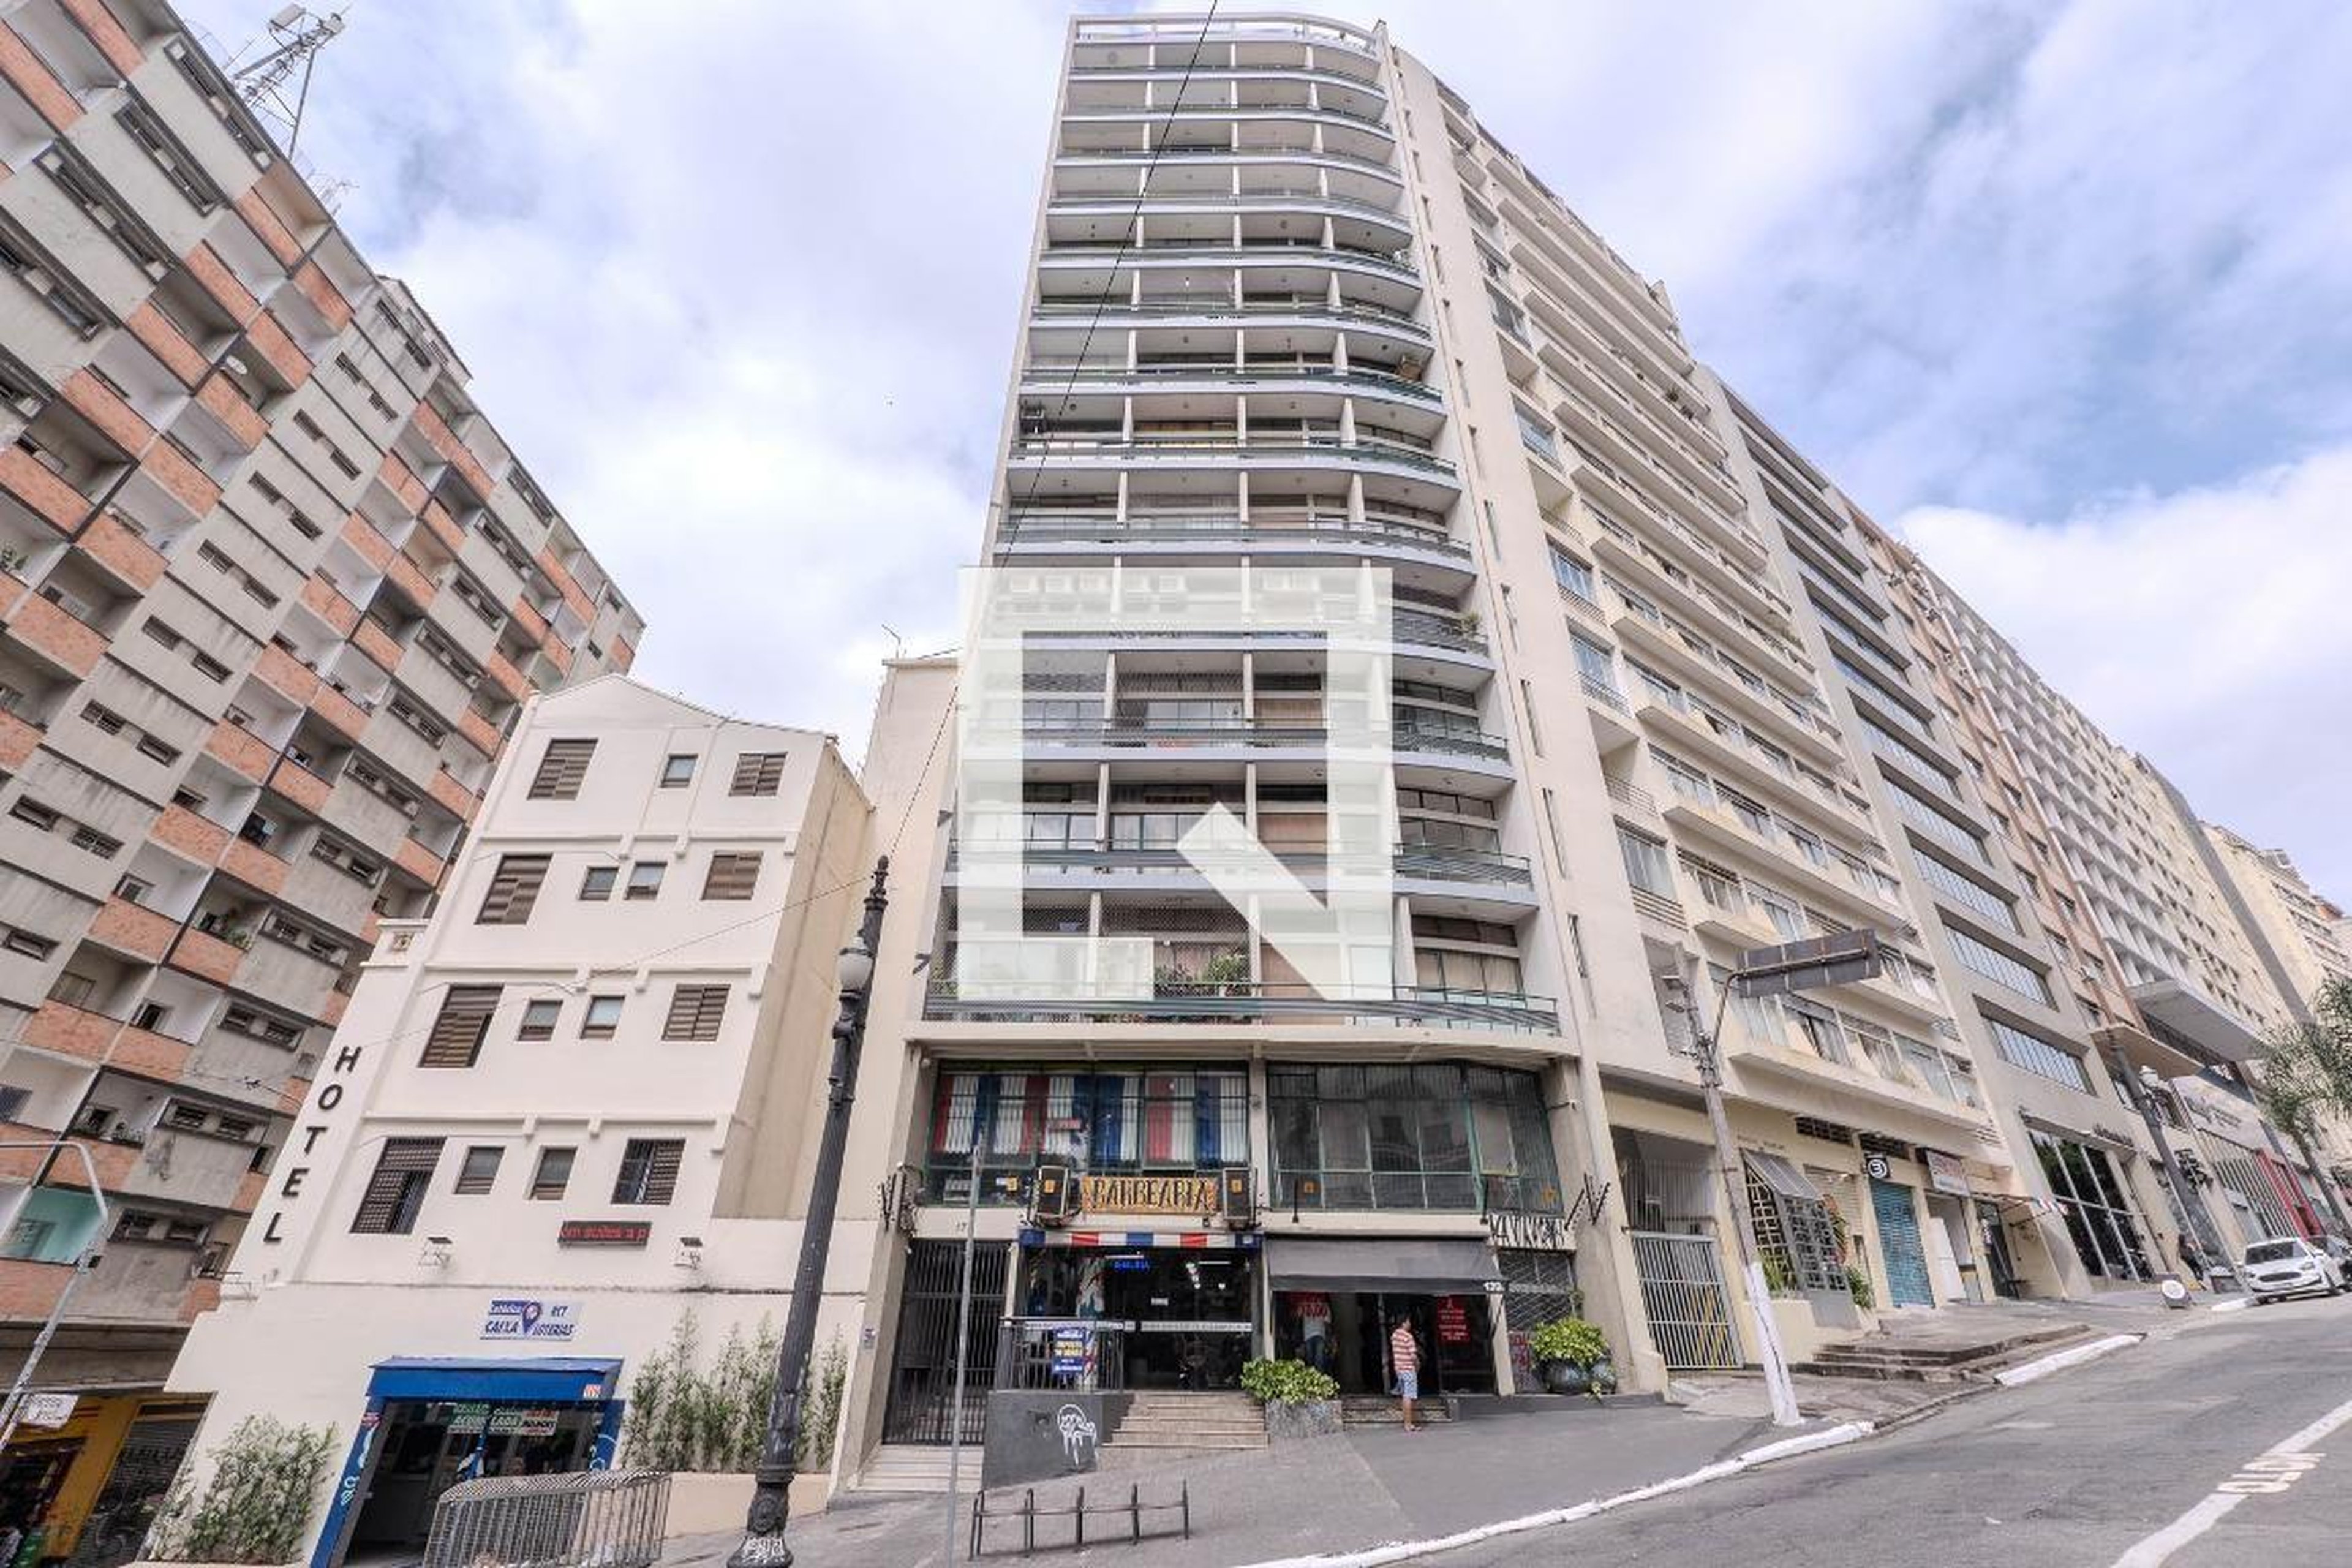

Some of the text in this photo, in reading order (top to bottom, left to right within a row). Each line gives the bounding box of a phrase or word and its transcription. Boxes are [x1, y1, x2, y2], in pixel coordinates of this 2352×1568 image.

[263, 1046, 362, 1242] HOTEL
[1093, 1178, 1210, 1212] BARBEARIA
[484, 1320, 519, 1334] CAIXA
